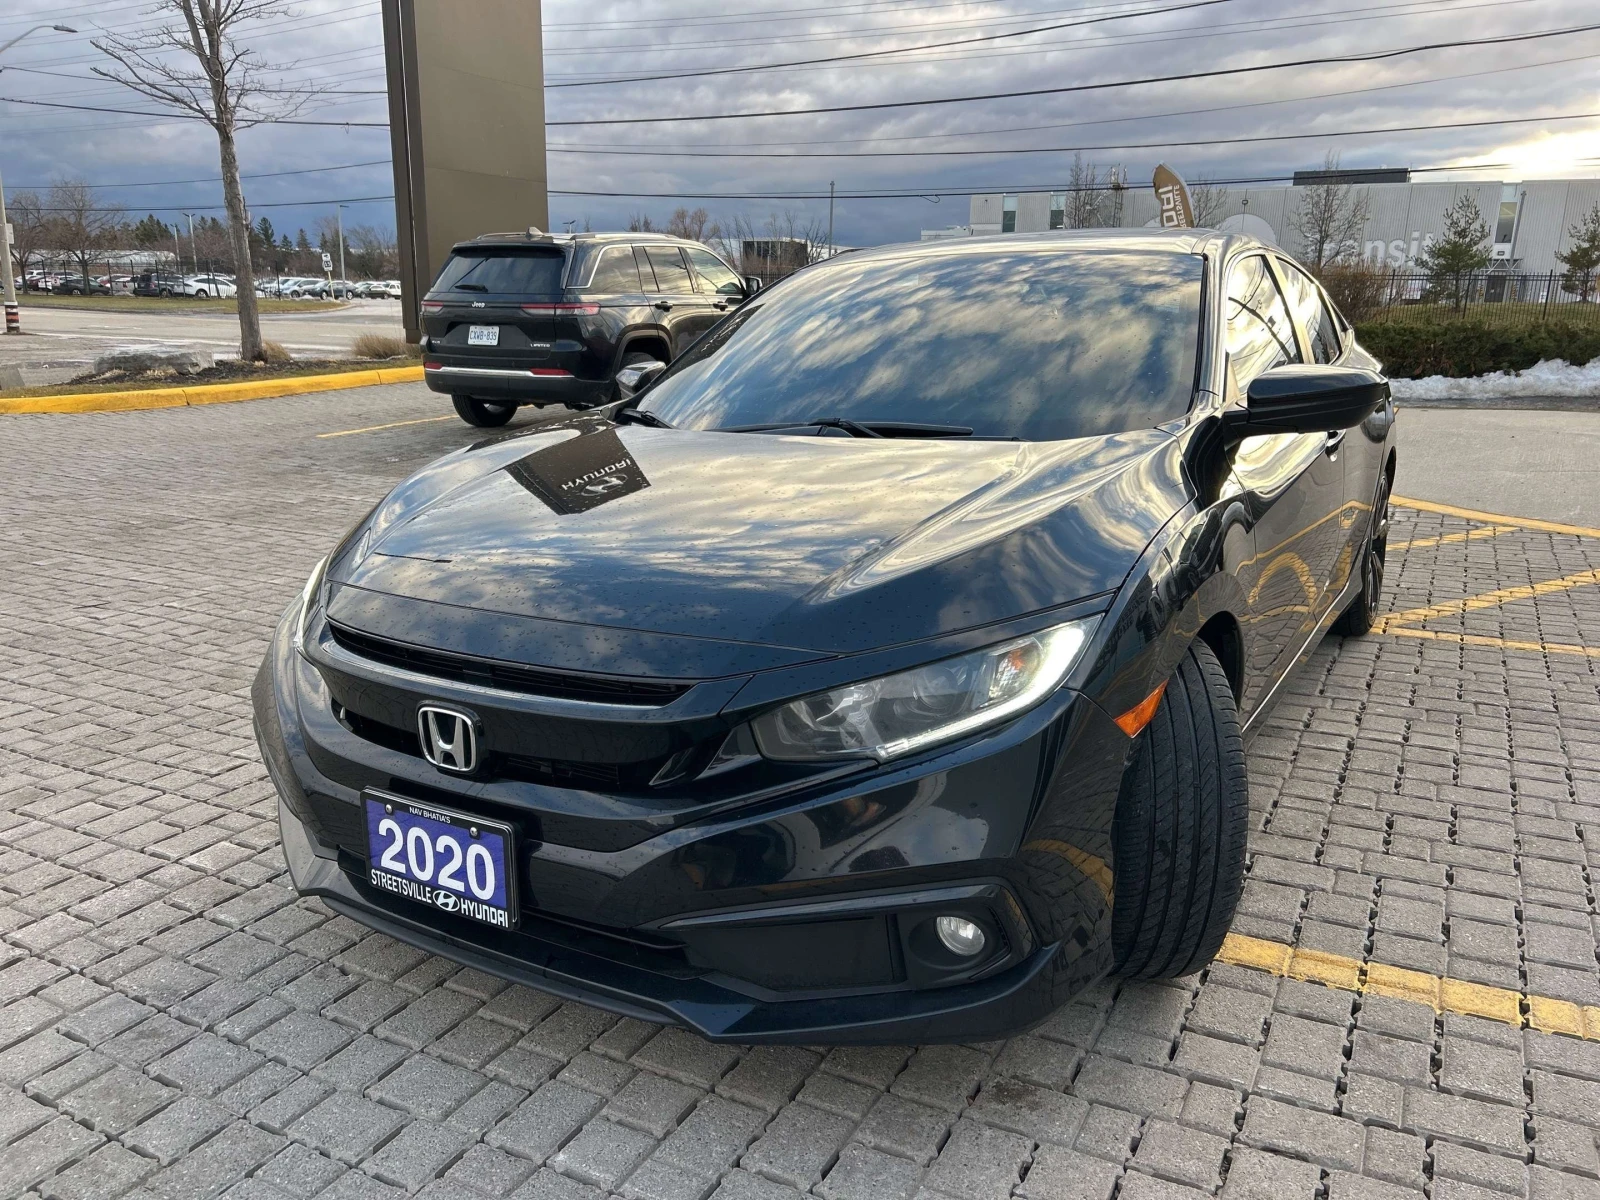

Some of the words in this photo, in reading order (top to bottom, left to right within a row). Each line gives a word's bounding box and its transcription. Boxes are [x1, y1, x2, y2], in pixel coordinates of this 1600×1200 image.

[471, 301, 486, 309] Jeep
[409, 806, 423, 816] NAV
[423, 810, 451, 824] BHATIA'S
[378, 818, 495, 901] 2020
[371, 869, 432, 904] STREETSVILLE
[461, 898, 509, 928] HYUNDAI
